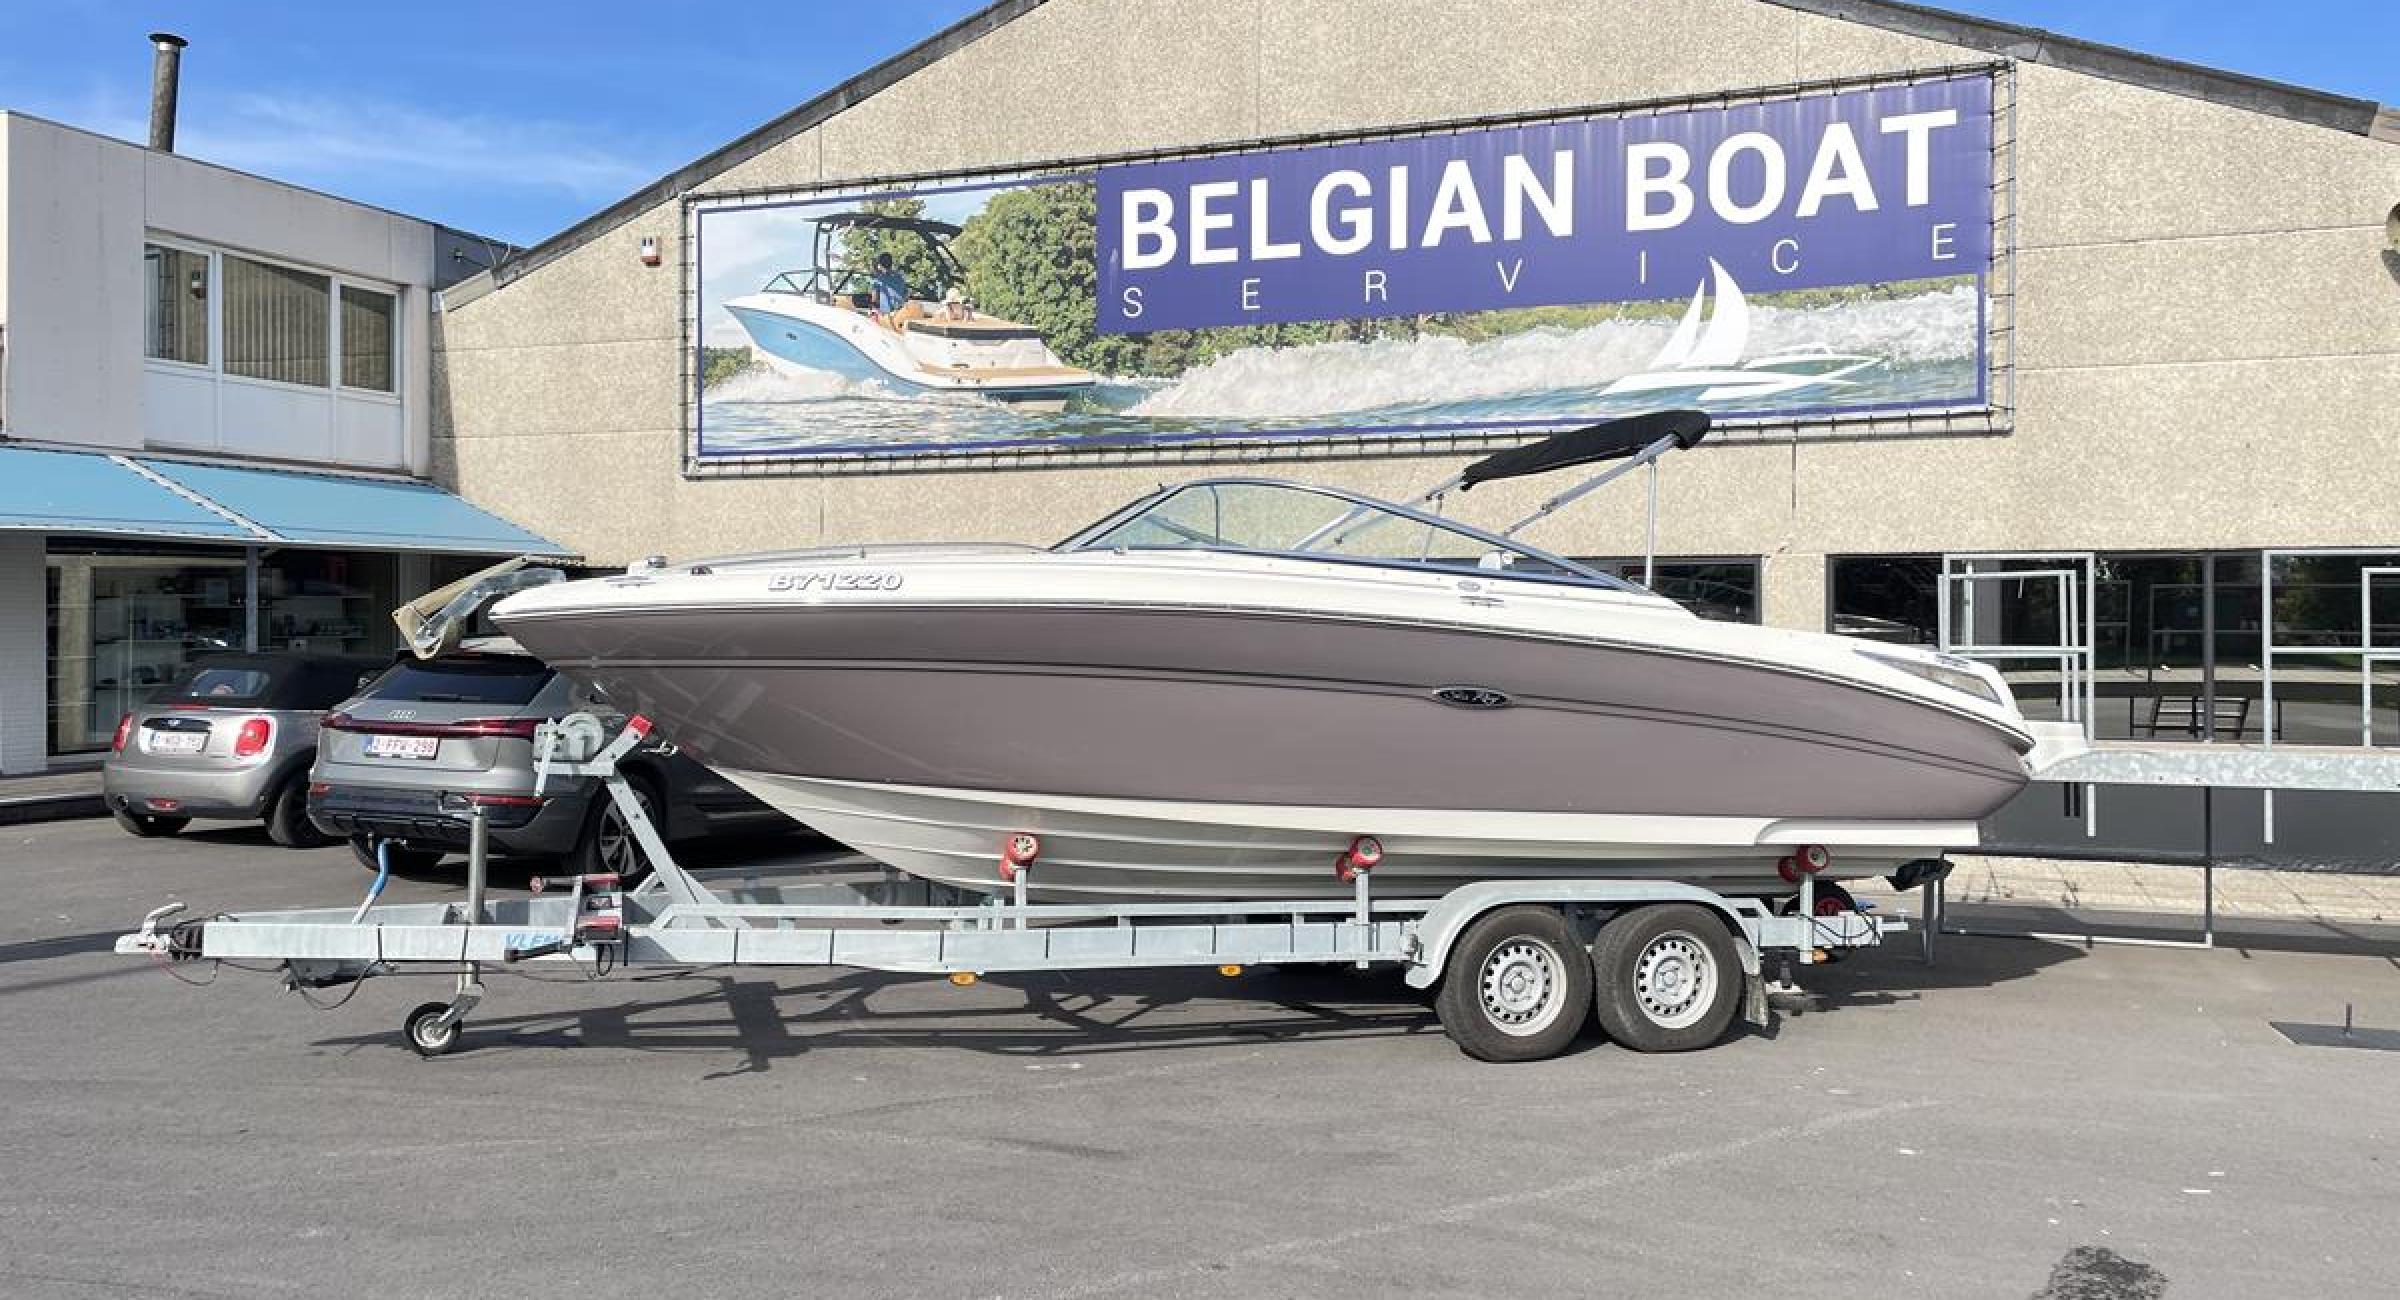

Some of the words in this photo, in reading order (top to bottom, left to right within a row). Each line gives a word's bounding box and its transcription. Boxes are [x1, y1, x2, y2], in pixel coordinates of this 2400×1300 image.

[1123, 149, 1573, 269] BELGIAN
[1626, 109, 1957, 231] BOAT
[1122, 223, 1956, 318] SERVICE
[767, 571, 904, 592] B71220
